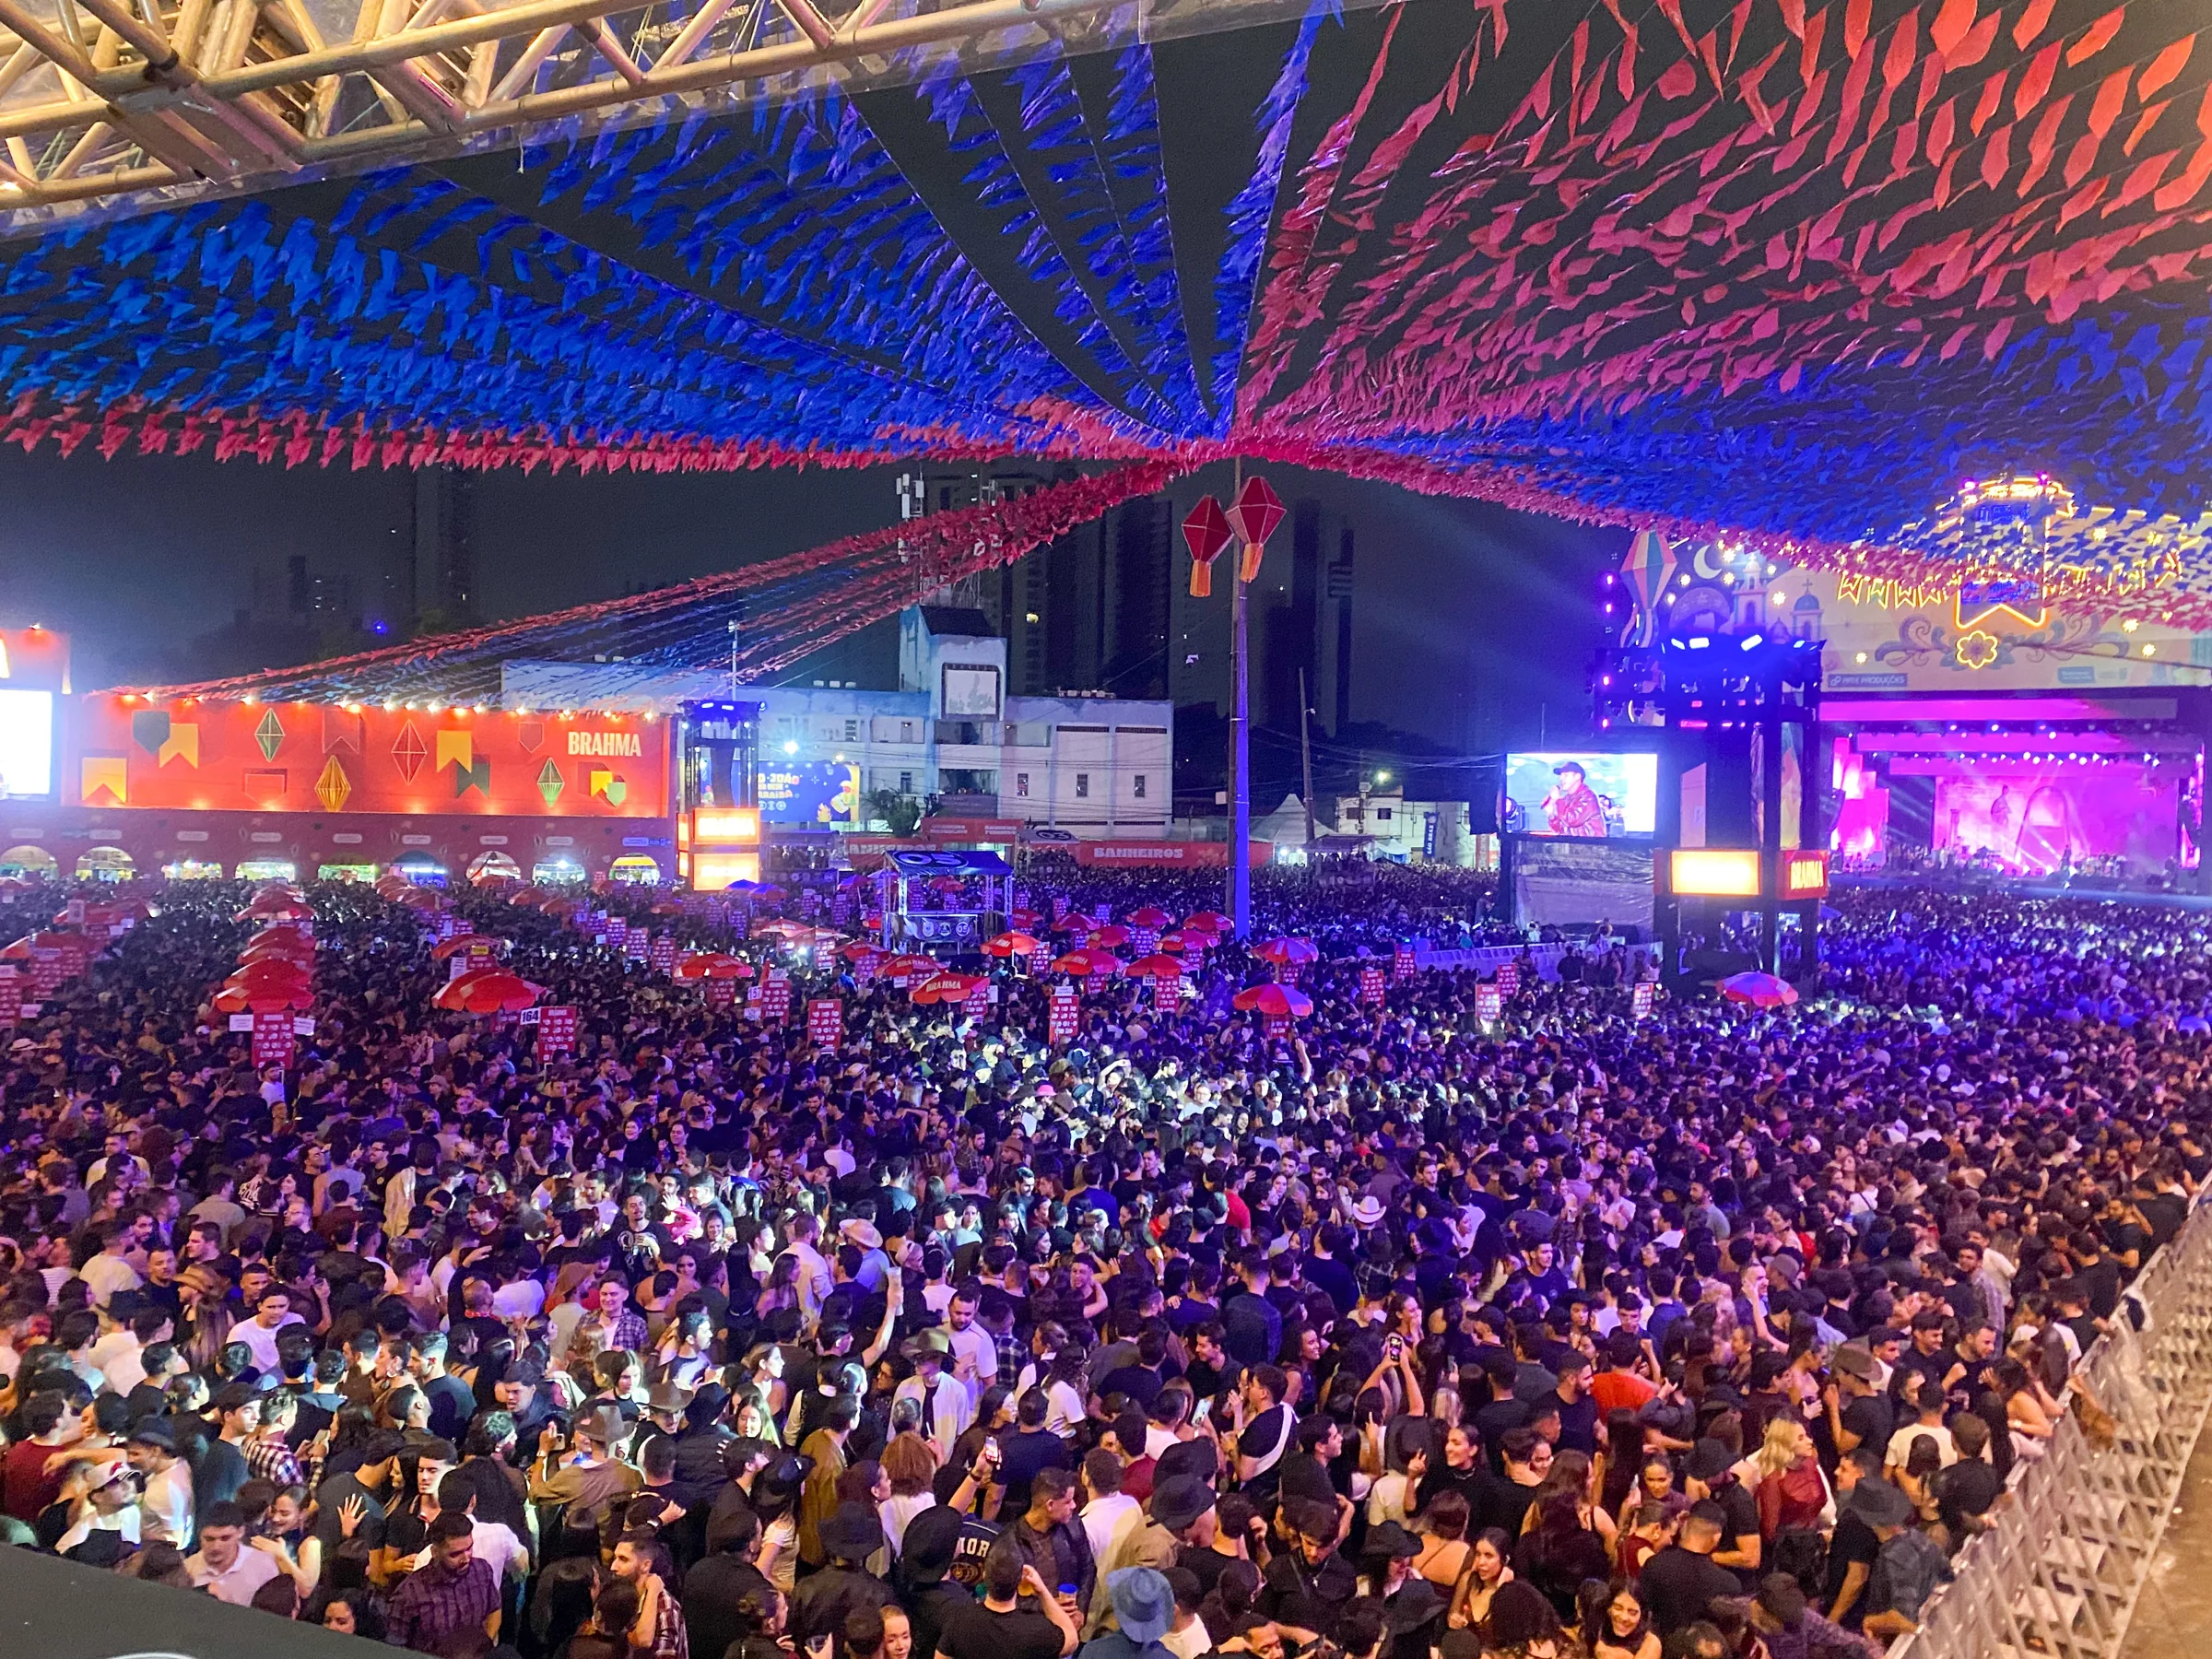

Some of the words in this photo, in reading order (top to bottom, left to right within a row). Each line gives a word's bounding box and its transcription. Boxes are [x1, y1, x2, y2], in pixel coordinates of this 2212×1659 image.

[568, 731, 641, 757] BRAHMA
[899, 853, 961, 865] 05
[1093, 847, 1183, 858] BANHEIROS
[1790, 860, 1824, 890] BRAHMA
[925, 980, 961, 993] BRAHMA
[522, 1009, 539, 1023] 164
